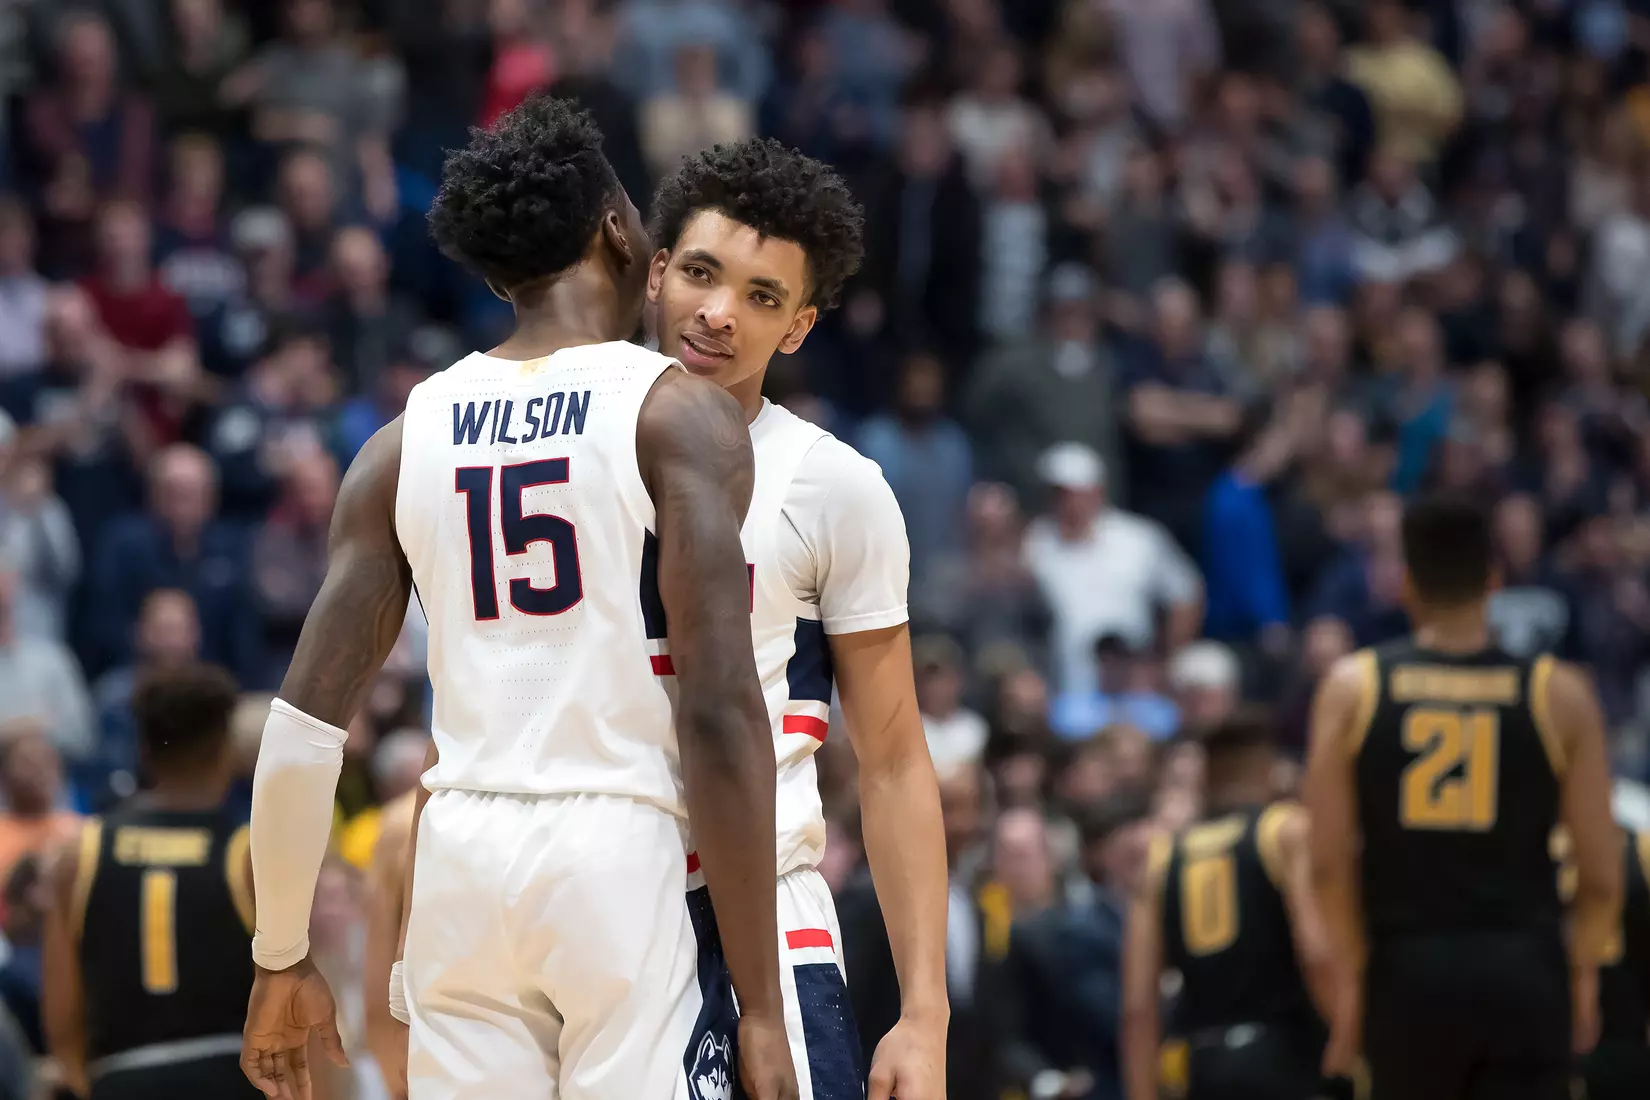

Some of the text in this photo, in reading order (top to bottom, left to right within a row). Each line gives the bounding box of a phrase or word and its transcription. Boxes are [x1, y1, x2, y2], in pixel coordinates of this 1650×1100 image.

[452, 390, 591, 446] WILSON
[455, 456, 583, 621] 15
[1399, 705, 1498, 831] 21
[141, 869, 178, 994] 1
[1182, 856, 1238, 955] 0
